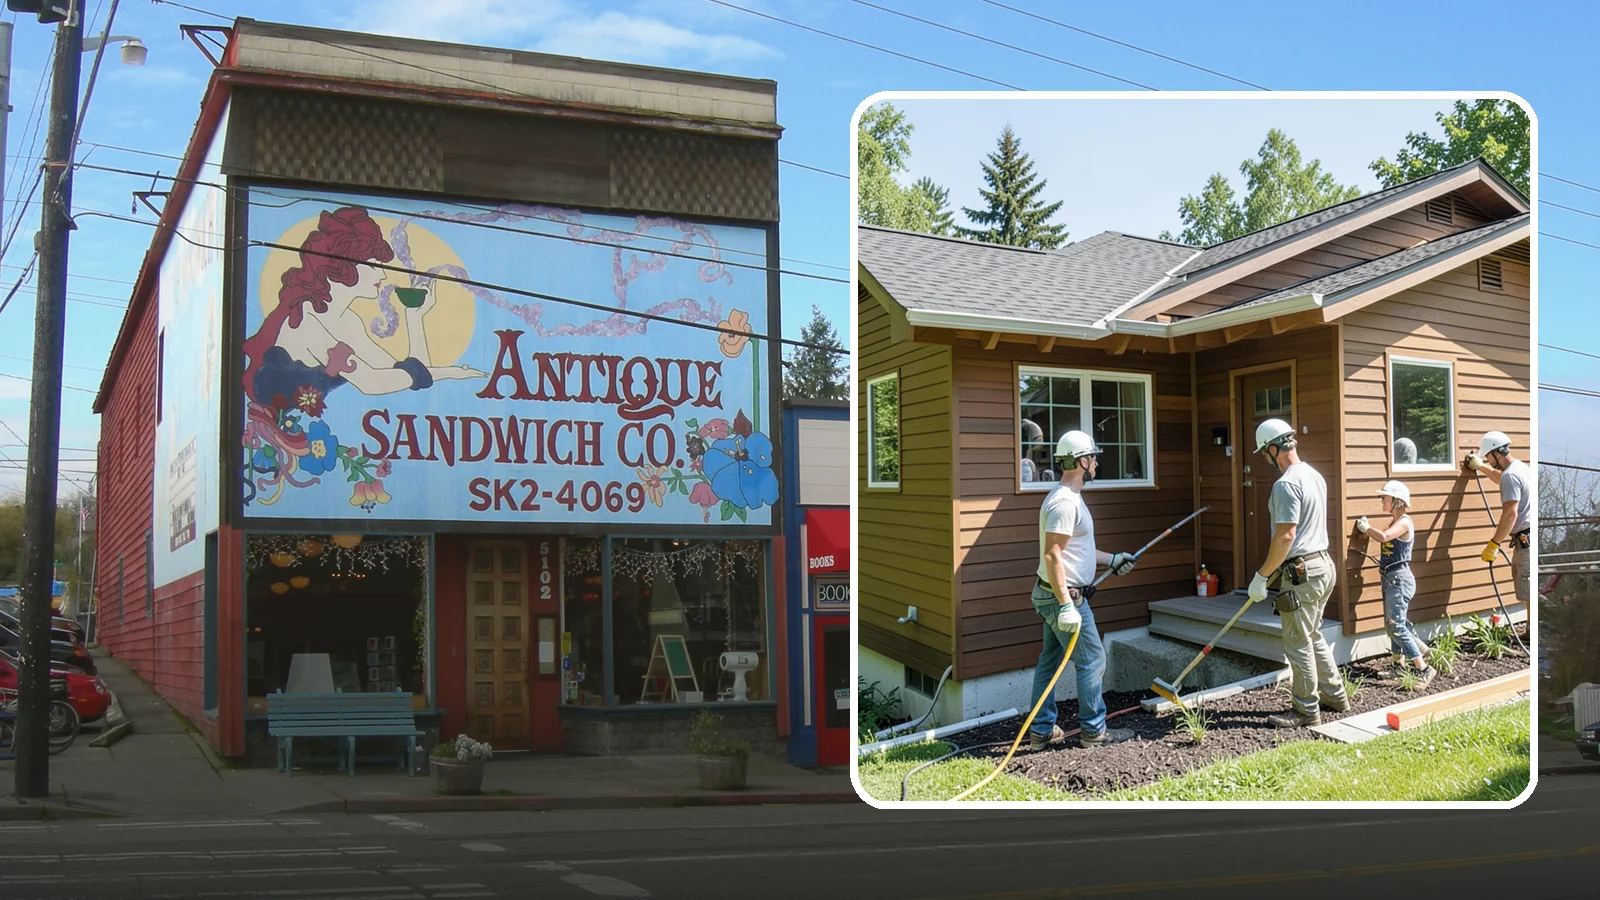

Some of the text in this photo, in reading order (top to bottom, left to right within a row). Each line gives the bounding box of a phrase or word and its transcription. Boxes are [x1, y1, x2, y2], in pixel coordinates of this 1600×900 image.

[475, 329, 724, 421] ANTIQUE
[361, 408, 685, 469] SANDWICH CO.
[468, 477, 646, 513] SK2-4069
[540, 541, 551, 600] 5102
[809, 555, 835, 569] BOOKS
